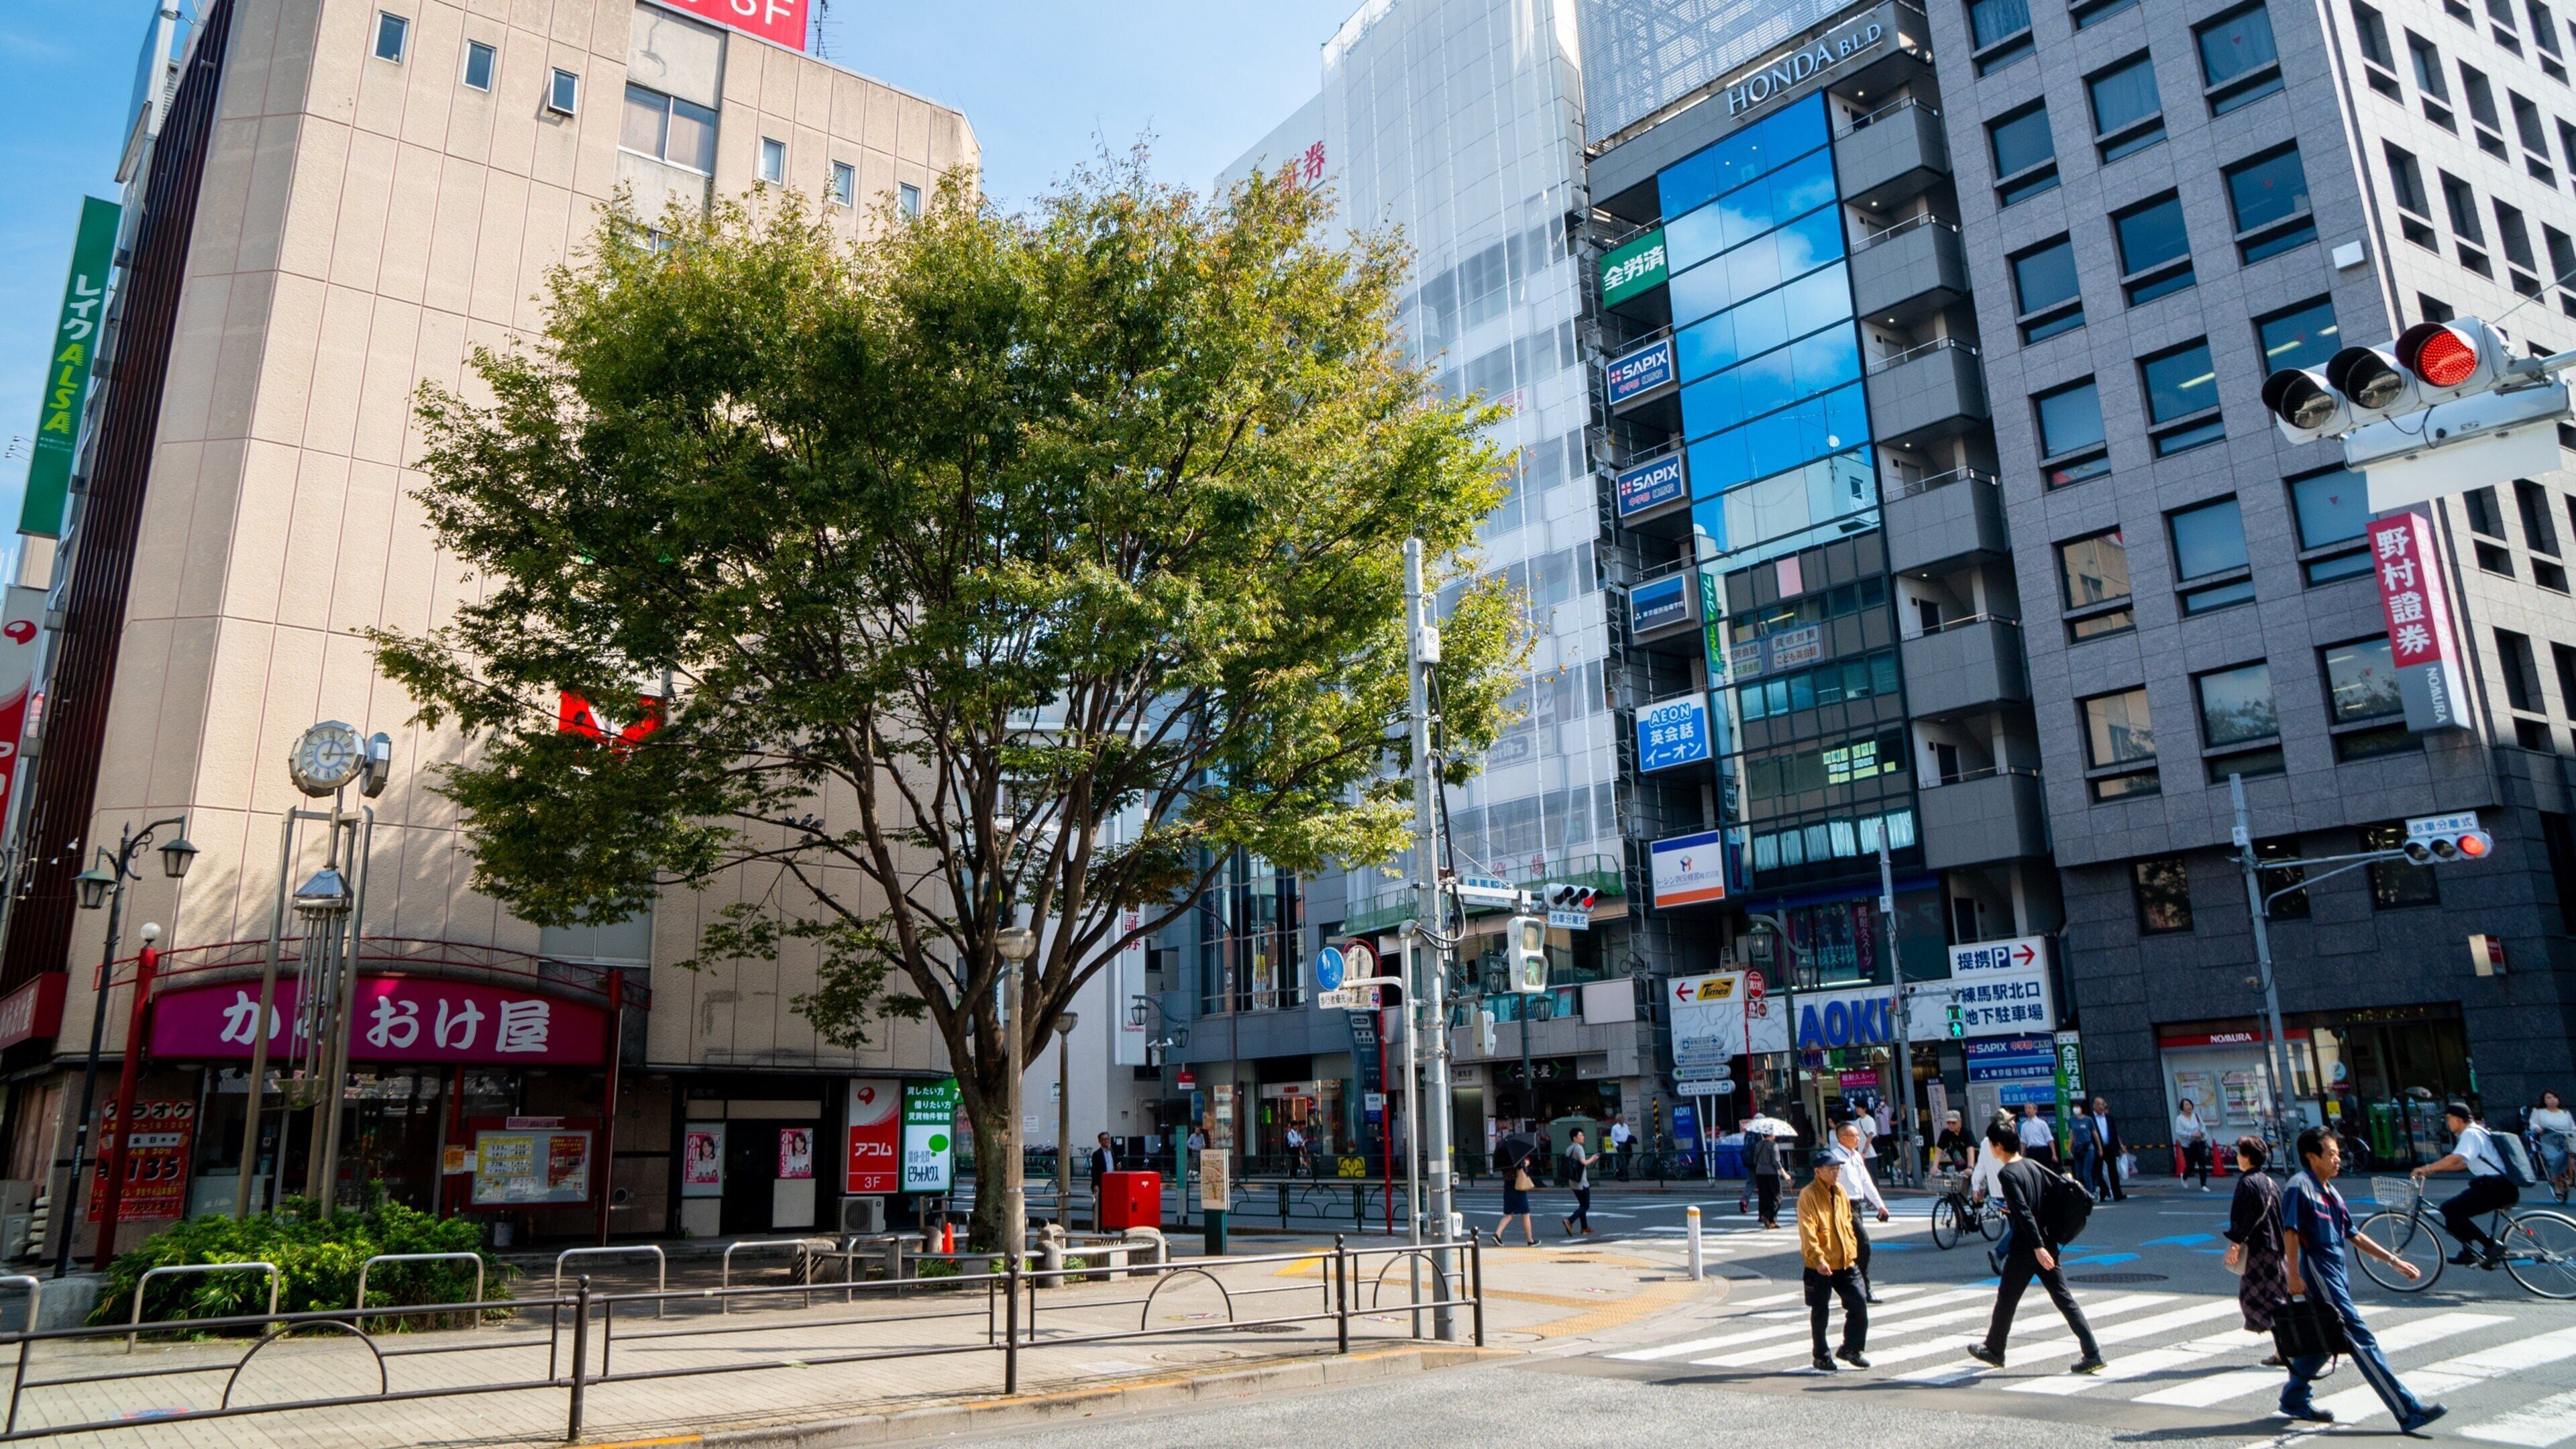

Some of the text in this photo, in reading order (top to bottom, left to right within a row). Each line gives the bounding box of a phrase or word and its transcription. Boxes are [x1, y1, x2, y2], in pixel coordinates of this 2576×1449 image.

[1727, 44, 1836, 115] HONDA
[1603, 246, 1664, 291] 全労済
[64, 274, 101, 340] レイク
[1622, 350, 1667, 380] SAPIX
[44, 343, 85, 434] ALSA
[1633, 464, 1678, 492] SAPIX
[2375, 525, 2430, 656] 野村證券
[2426, 666, 2447, 724] NOMURA
[1650, 703, 1691, 726] AEON
[1650, 723, 1694, 746] 英会話
[1645, 741, 1702, 766] イーオン
[2413, 817, 2473, 833] 歩車分離式
[1552, 913, 1587, 926] 歩車分離式
[1957, 951, 1990, 971] 提携
[1702, 984, 1729, 998] Times
[1962, 982, 2040, 1004] 練馬駅北口
[221, 990, 550, 1053] かおけ屋
[1798, 998, 1892, 1048] AOKI
[1965, 1004, 2043, 1026] 地下駐車場
[1976, 1042, 2007, 1054] SAPIX
[2210, 1033, 2252, 1043] NOMURA
[907, 1087, 944, 1095] 貸したい方
[914, 1100, 951, 1109] 借りたい方
[1674, 1106, 1690, 1117] AOKI
[855, 1142, 892, 1157] アコム
[865, 1177, 881, 1188] 3F
